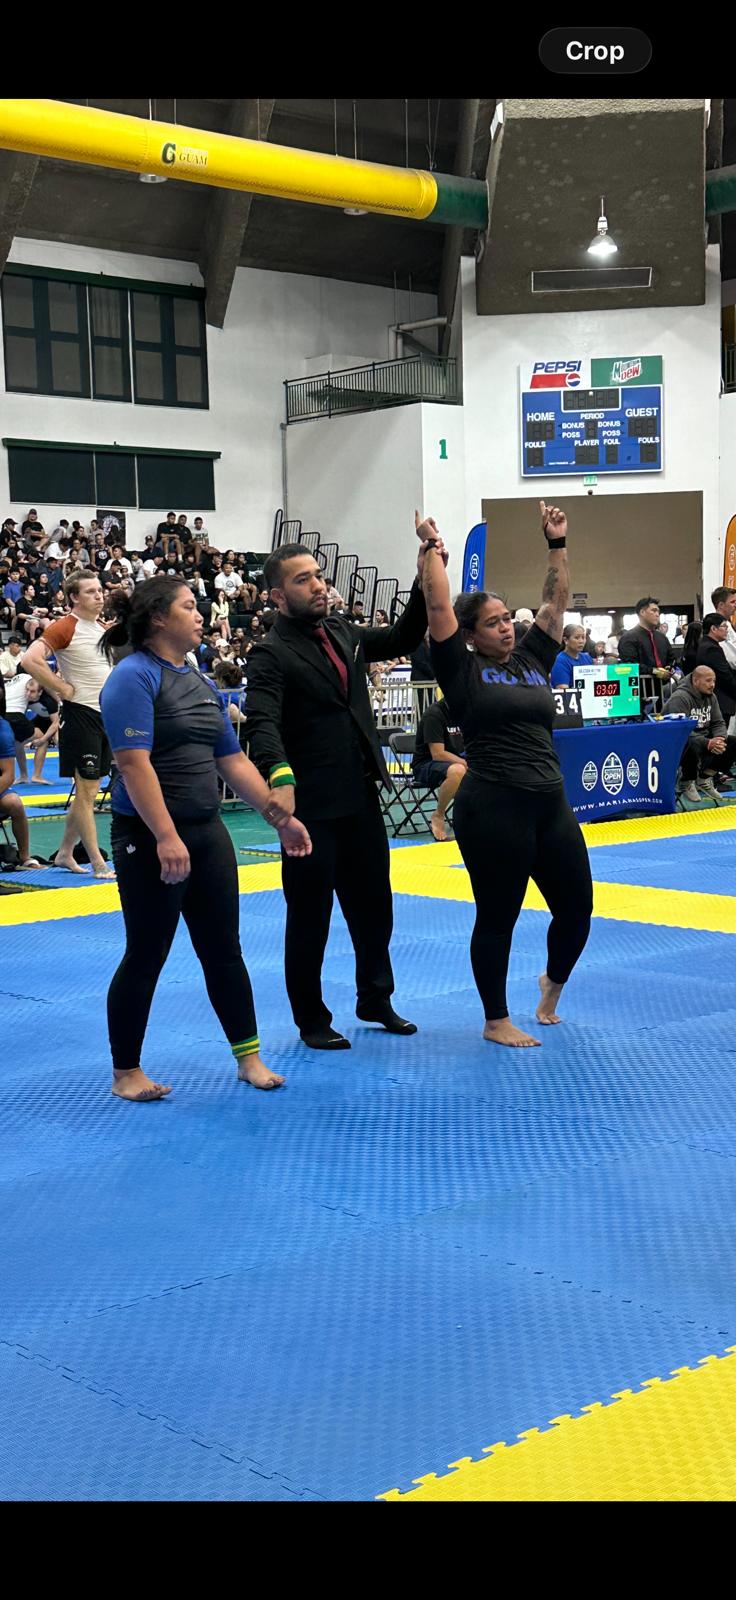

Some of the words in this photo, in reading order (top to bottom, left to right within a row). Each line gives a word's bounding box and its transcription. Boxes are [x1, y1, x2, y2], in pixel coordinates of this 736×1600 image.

[179, 152, 208, 166] GUAM
[533, 360, 582, 374] PEPSI
[526, 412, 556, 421] HOME
[580, 412, 605, 420] PERIOD
[625, 408, 659, 417] GUEST
[597, 420, 621, 428] BONUS
[439, 438, 449, 459] 1
[481, 667, 548, 686] GUM
[603, 698, 612, 708] 34
[647, 749, 660, 794] 6
